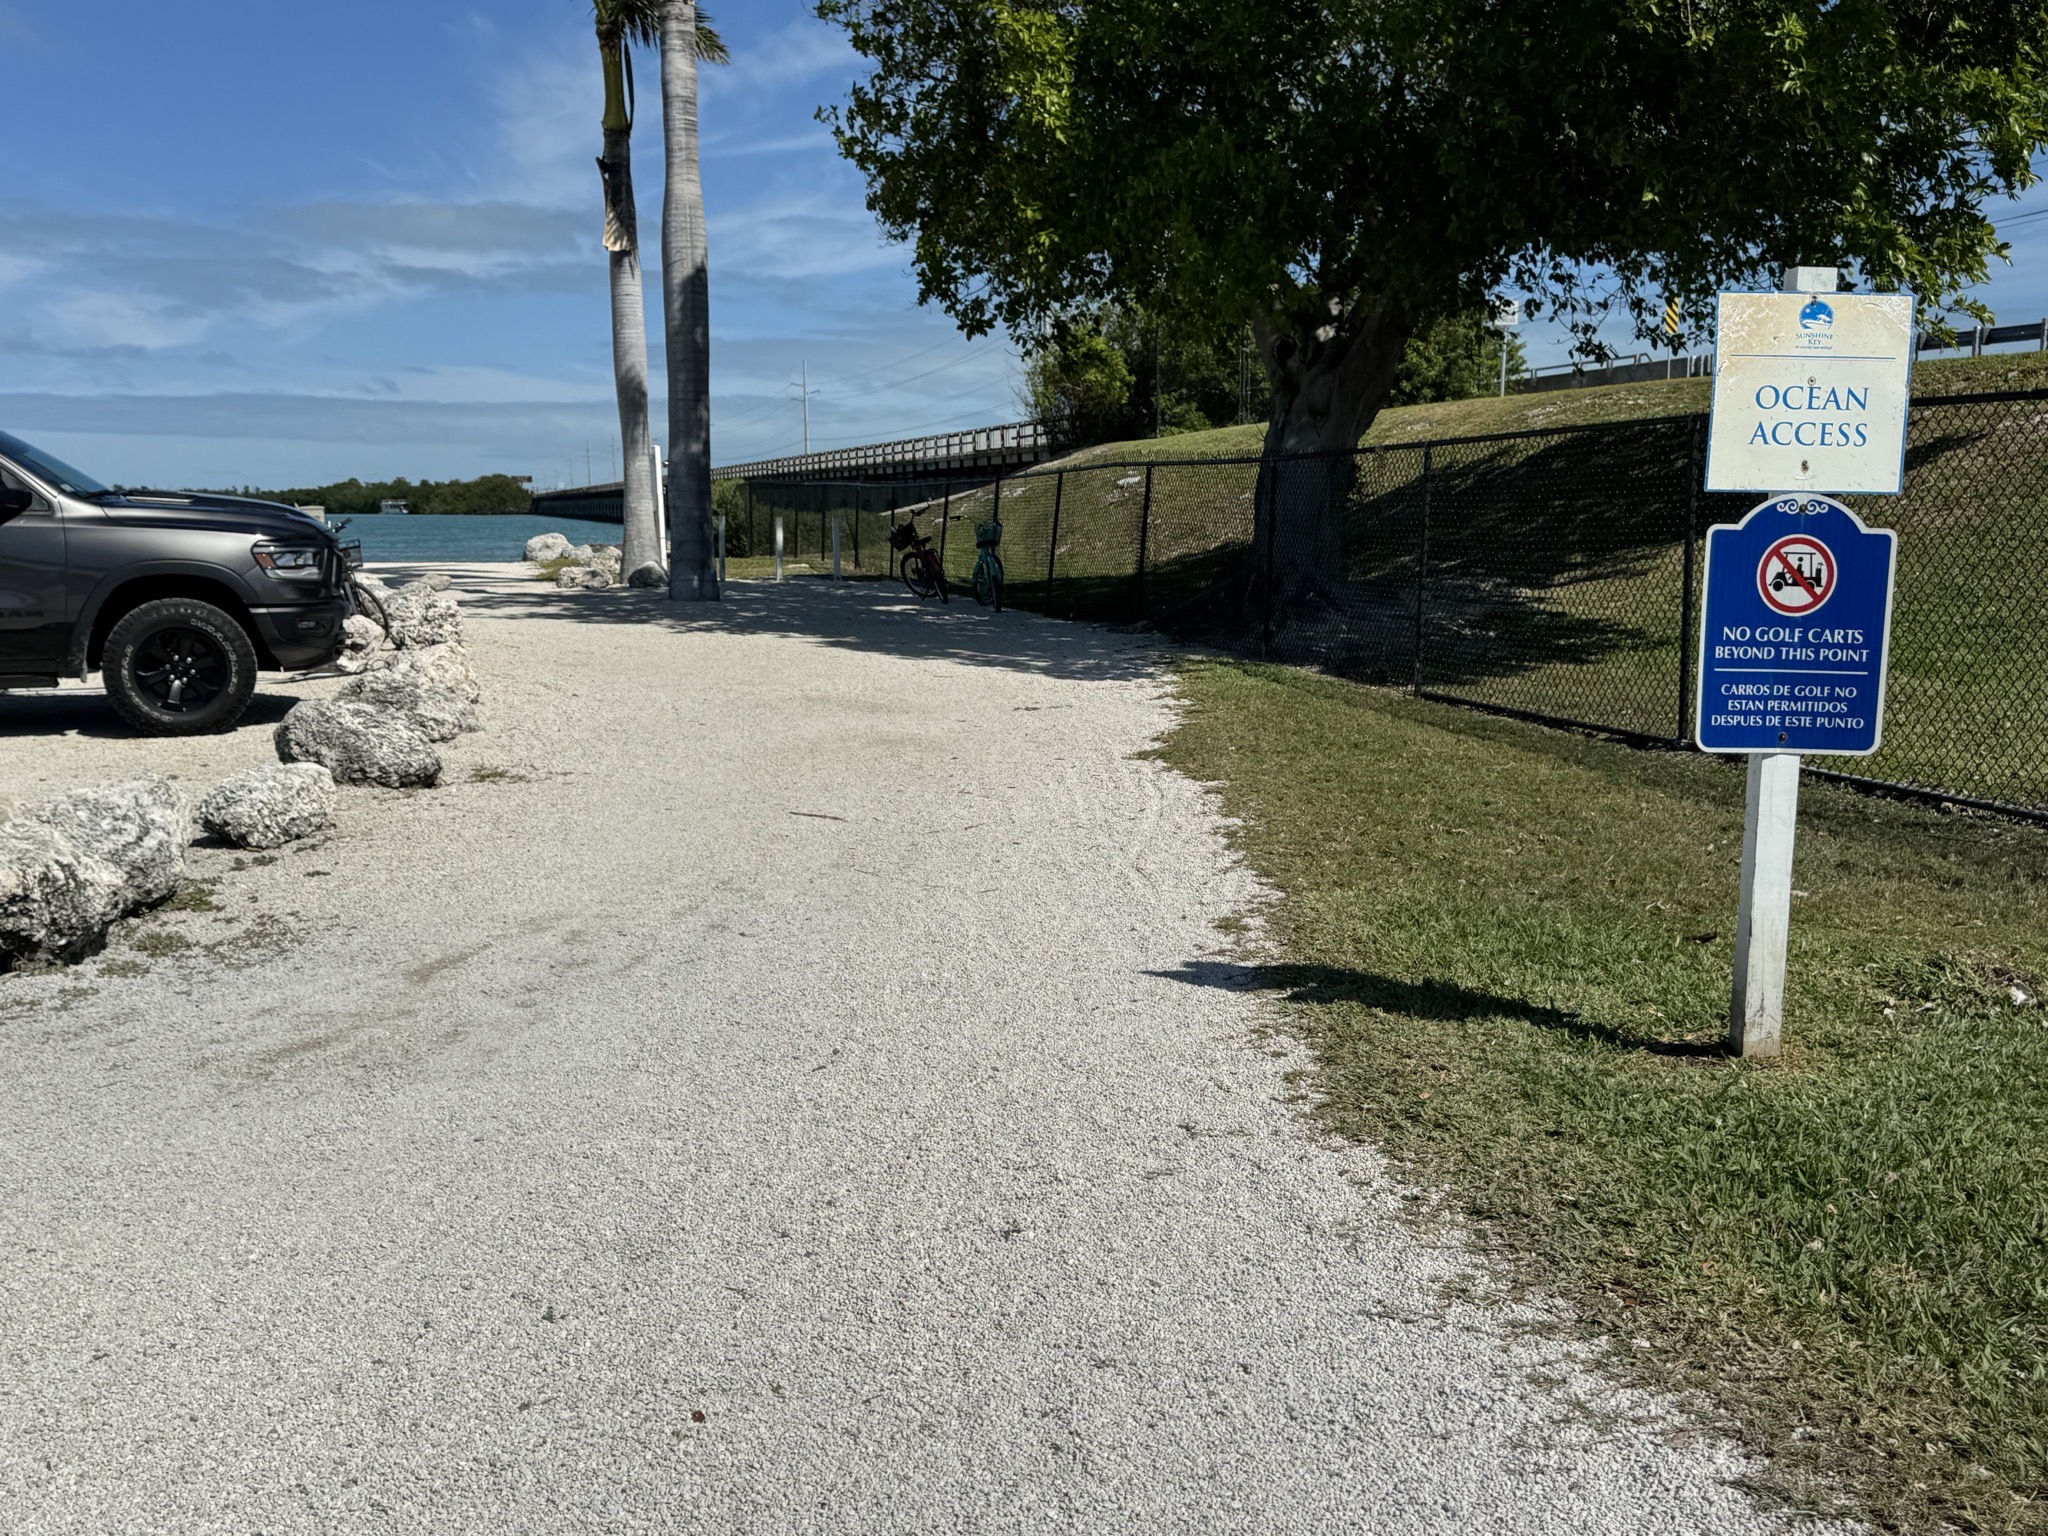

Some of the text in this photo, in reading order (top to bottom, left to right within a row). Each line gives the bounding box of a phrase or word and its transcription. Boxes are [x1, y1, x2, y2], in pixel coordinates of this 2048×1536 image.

[1795, 332, 1833, 340] SUNSHINE
[1755, 384, 1870, 411] OCEAN
[1748, 421, 1868, 446] ACCESS
[1723, 626, 1863, 644] NO GOLF CARTS
[1715, 646, 1869, 662] BEYOND THIS POINT
[1721, 684, 1857, 698] CARROS DE GOLF NO
[1727, 699, 1848, 713] ESTAN PERMITIDOS
[1711, 715, 1864, 729] DESPUES DE ESTE PUNTO
